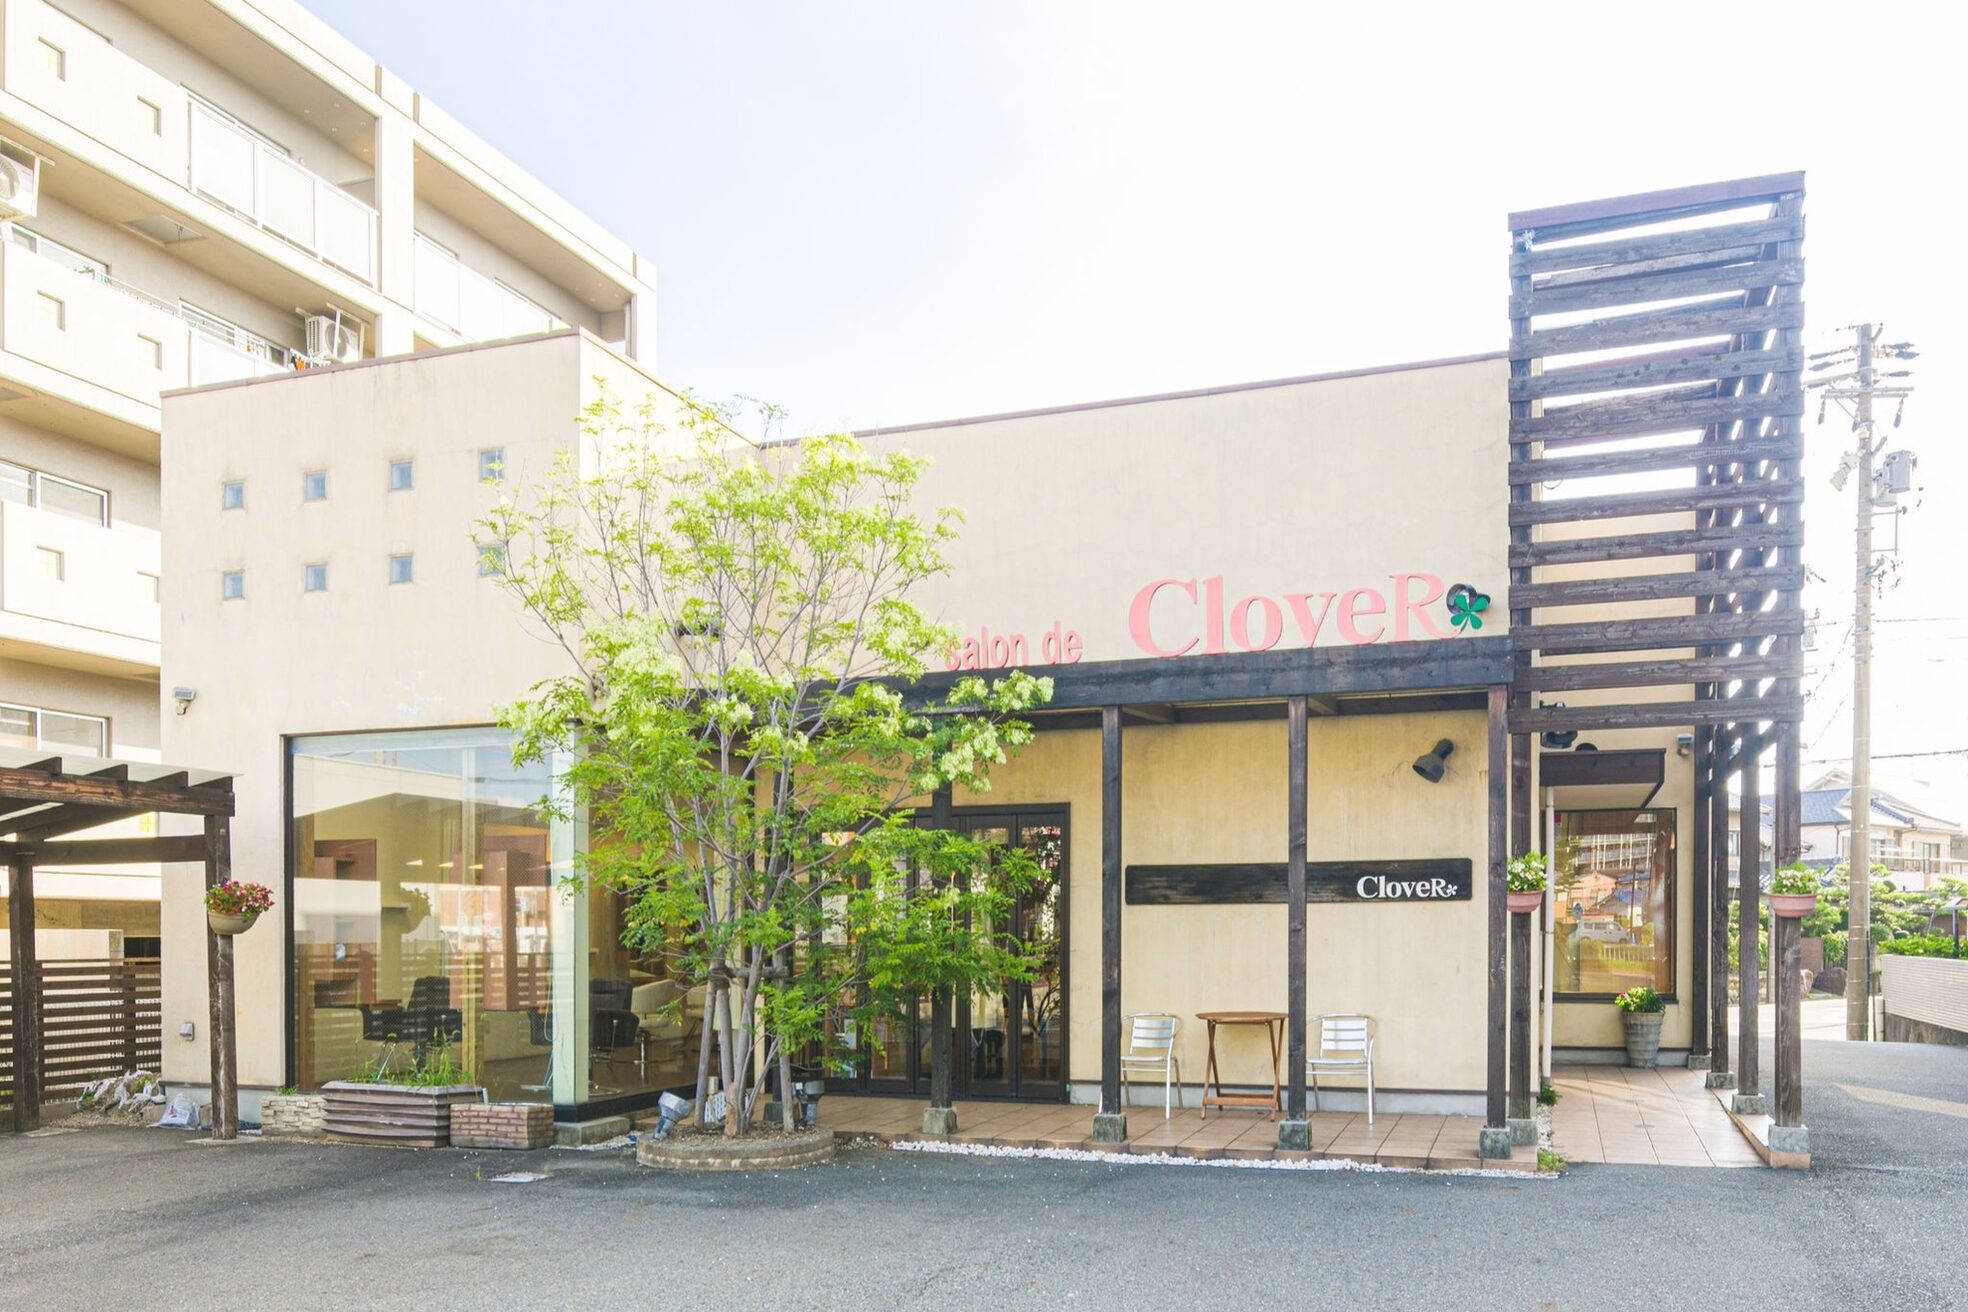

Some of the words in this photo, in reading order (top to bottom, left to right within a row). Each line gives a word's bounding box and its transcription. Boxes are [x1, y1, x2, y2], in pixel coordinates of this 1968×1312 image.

[944, 626, 1029, 672] salon
[1041, 619, 1083, 665] de
[1128, 572, 1462, 659] CloveR
[1356, 875, 1452, 899] CloveR
